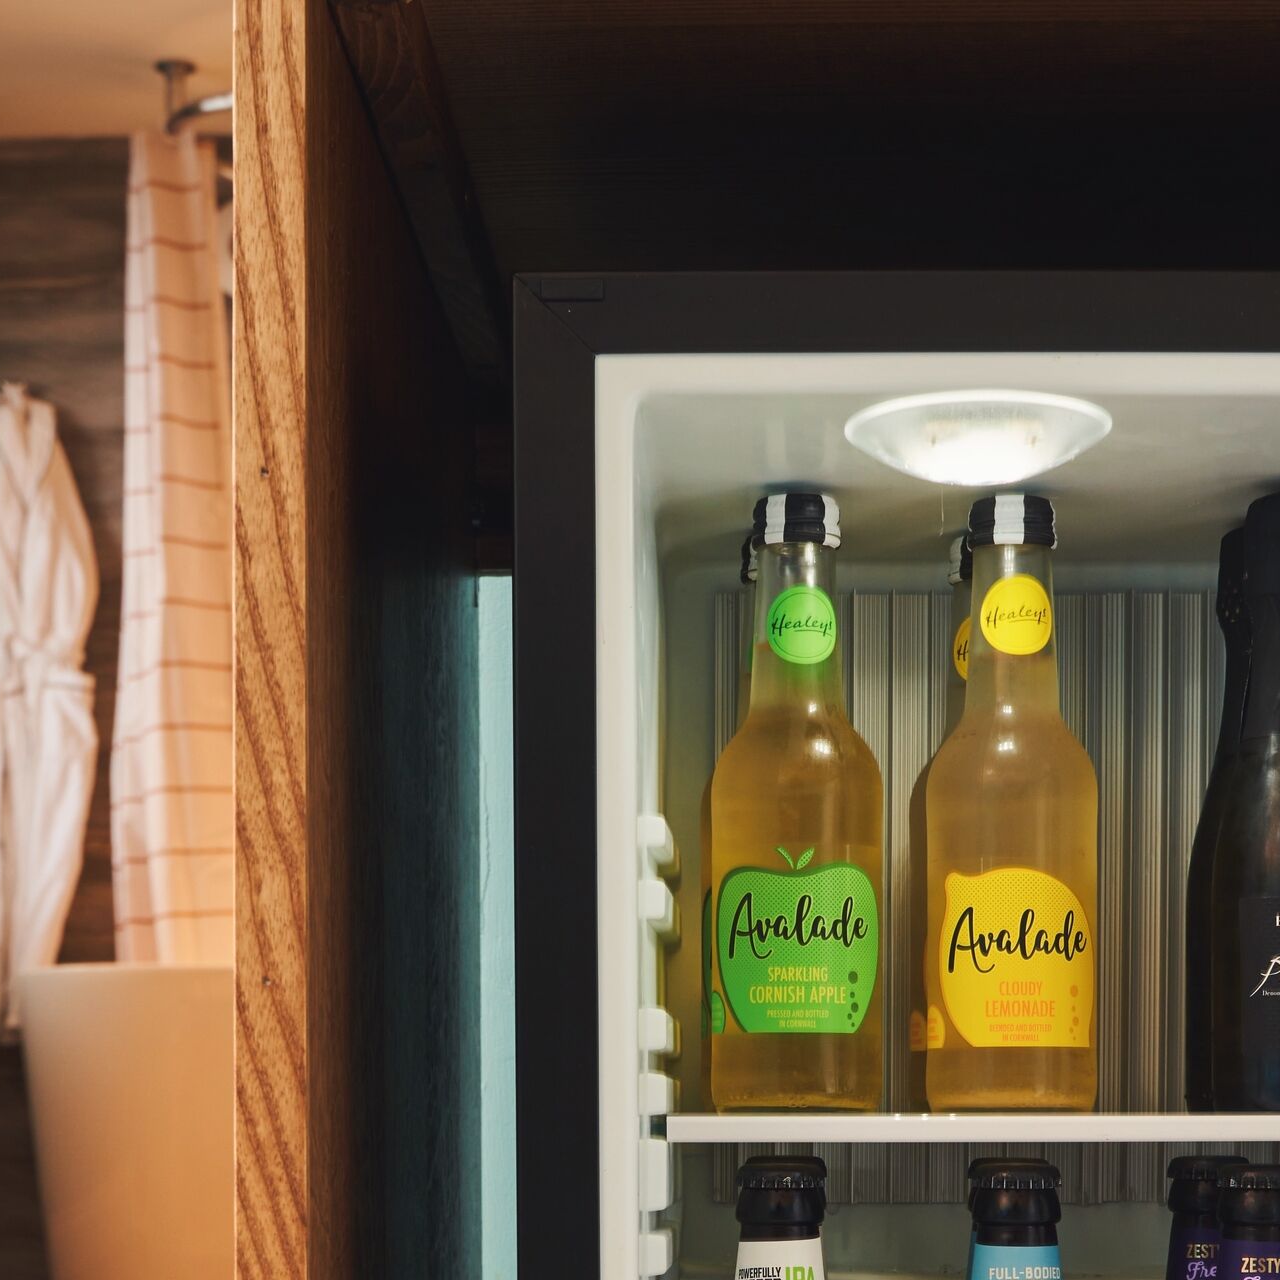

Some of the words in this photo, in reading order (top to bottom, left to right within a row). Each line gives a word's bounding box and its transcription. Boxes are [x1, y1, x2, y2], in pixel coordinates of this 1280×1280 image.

[986, 605, 1047, 628] Healeys
[771, 614, 832, 636] Healeys
[727, 892, 868, 959] Avalade
[948, 906, 1088, 973] Avalade
[768, 966, 828, 982] SPARKLING
[749, 986, 805, 1004] CORNISH
[810, 986, 847, 1004] APPLE
[999, 981, 1042, 996] CLOUDY
[767, 1009, 791, 1018] PRESSED
[791, 1009, 804, 1018] AND
[804, 1009, 830, 1018] BOTTLED
[985, 1000, 1056, 1018] LEMONADE
[779, 1020, 786, 1028] IN
[786, 1020, 817, 1028] CORNWALL
[1015, 1023, 1028, 1032] AND
[1027, 1023, 1052, 1032] BOTTLED
[1002, 1034, 1010, 1042] IN
[1010, 1034, 1040, 1042] CORNWALL
[738, 1267, 781, 1279] POWERFULLY
[989, 1266, 1060, 1280] FULL-BODIED
[1186, 1261, 1217, 1280] Fre
[1241, 1257, 1280, 1273] ZESTY
